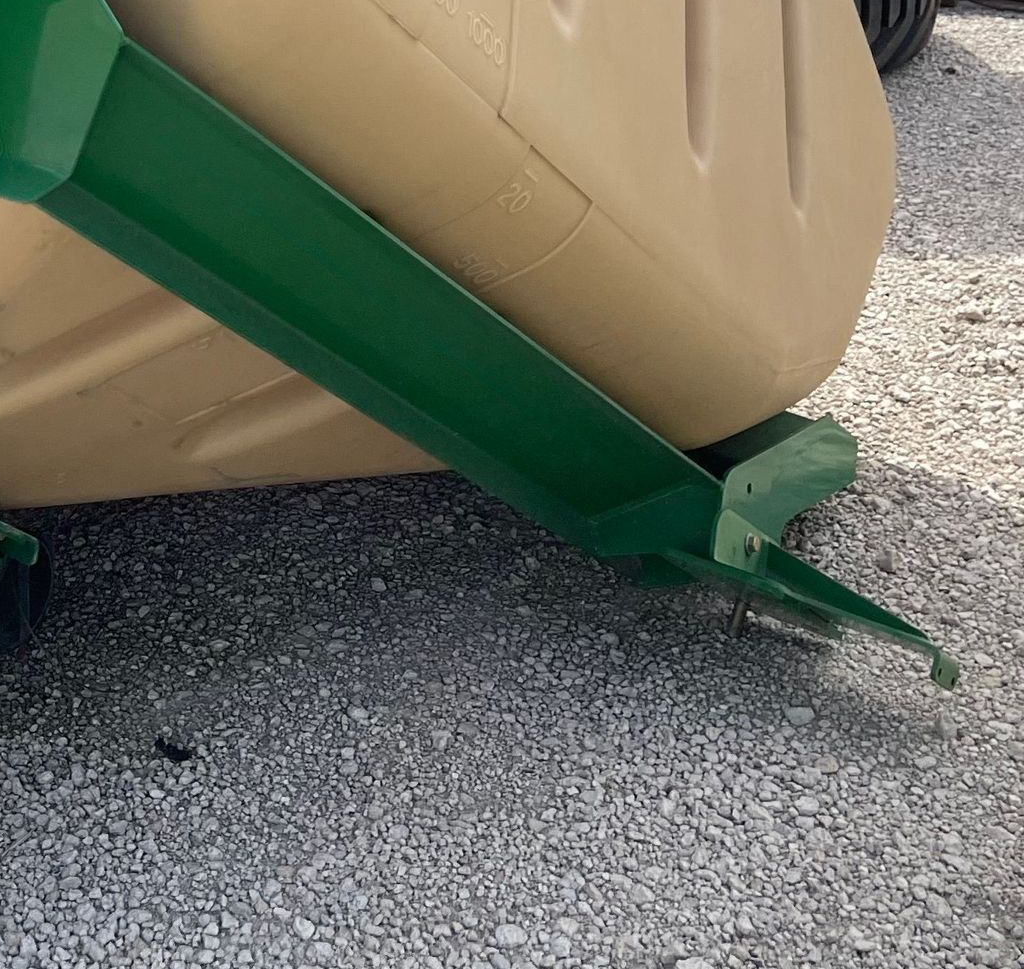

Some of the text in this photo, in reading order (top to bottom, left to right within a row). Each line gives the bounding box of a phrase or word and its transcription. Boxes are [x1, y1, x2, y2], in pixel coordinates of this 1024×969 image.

[466, 11, 507, 67] 1000
[496, 182, 534, 215] 20
[454, 254, 498, 285] 500
